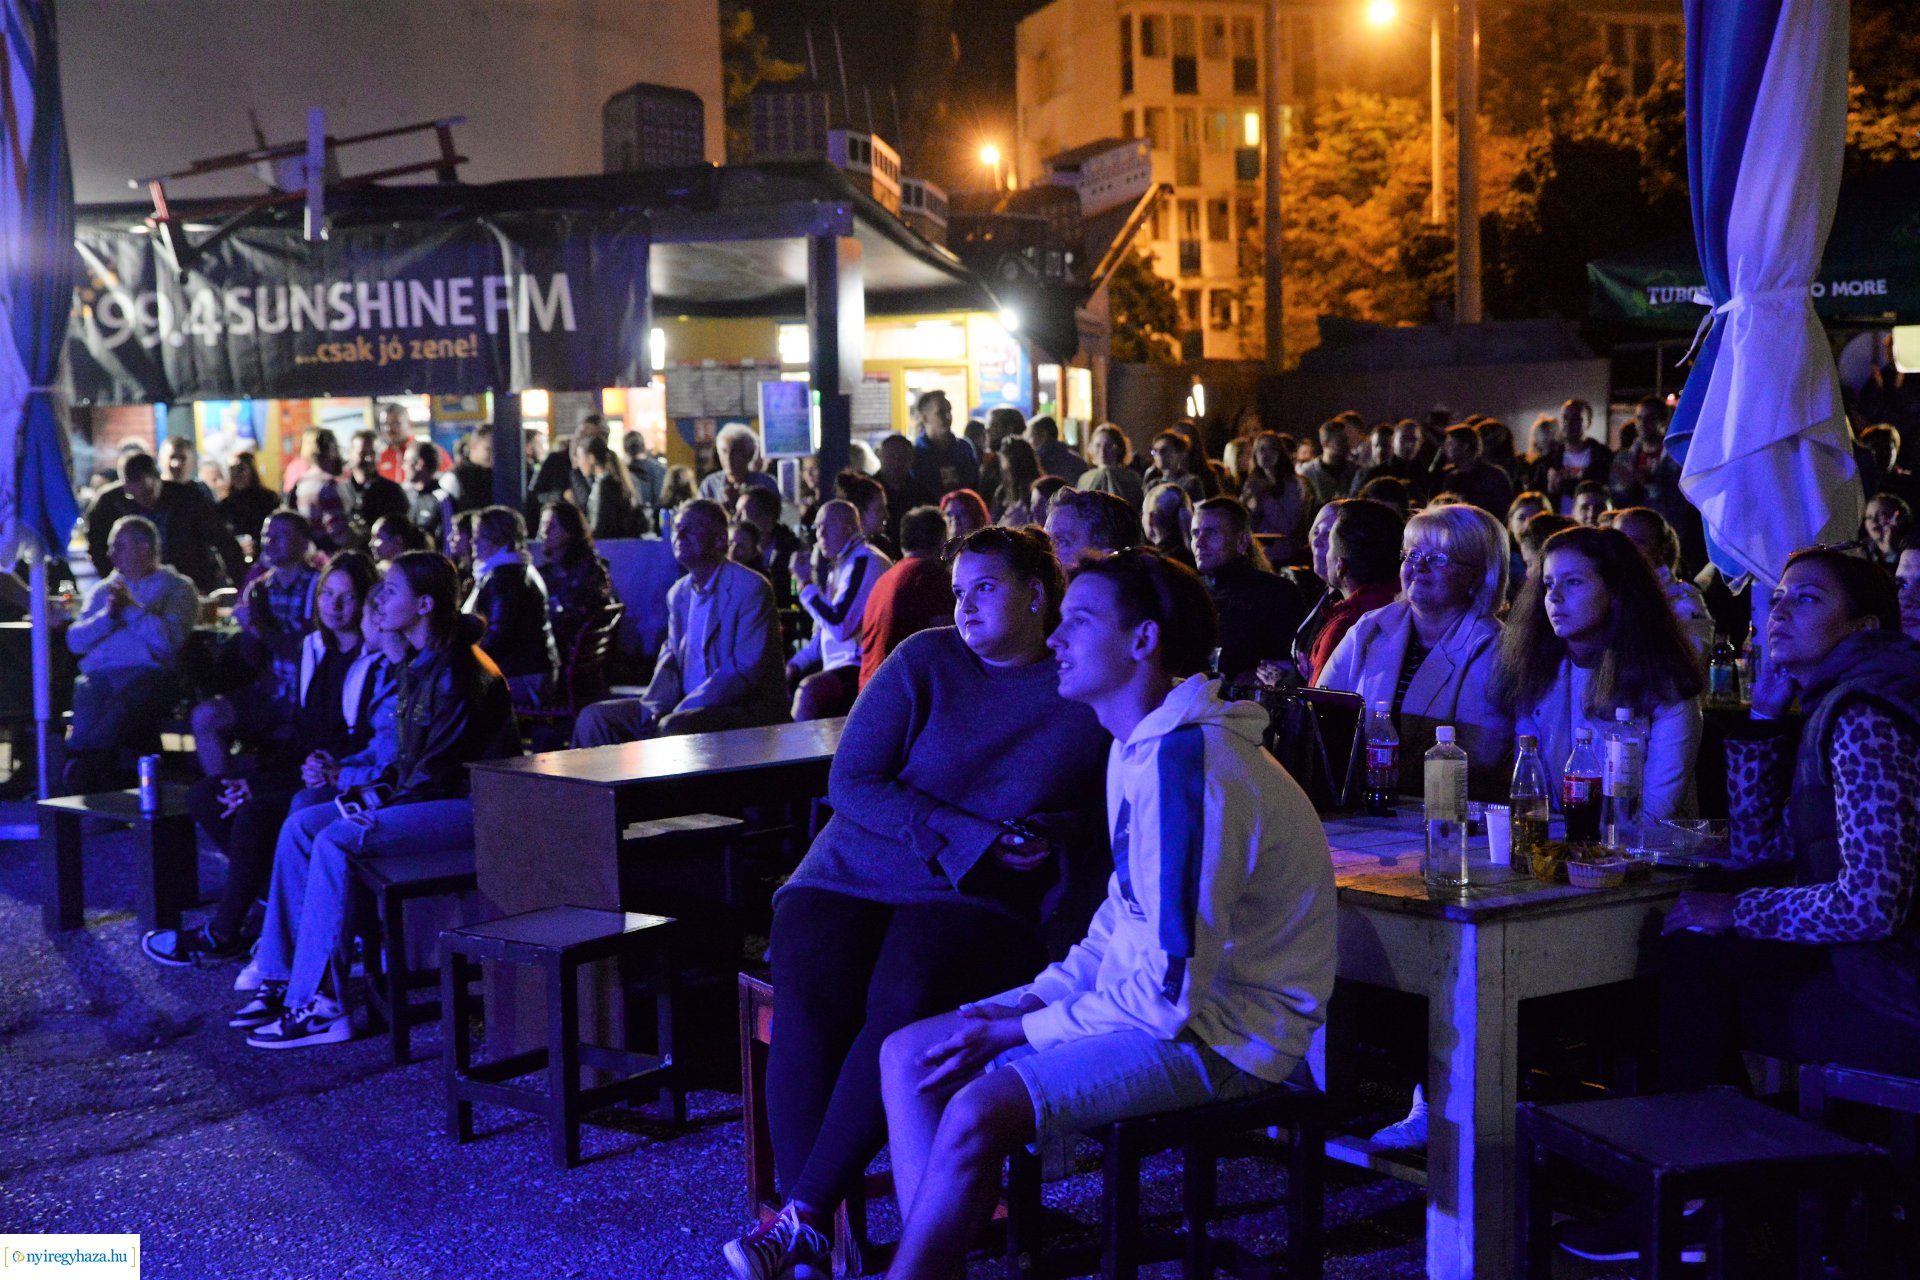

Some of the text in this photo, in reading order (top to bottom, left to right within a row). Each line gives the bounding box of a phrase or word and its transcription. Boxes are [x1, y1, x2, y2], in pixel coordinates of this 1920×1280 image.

[225, 277, 476, 335] SUNSHINE
[483, 272, 577, 334] FM
[1832, 278, 1887, 297] MORE
[378, 334, 405, 366] jó
[410, 333, 478, 360] zene!
